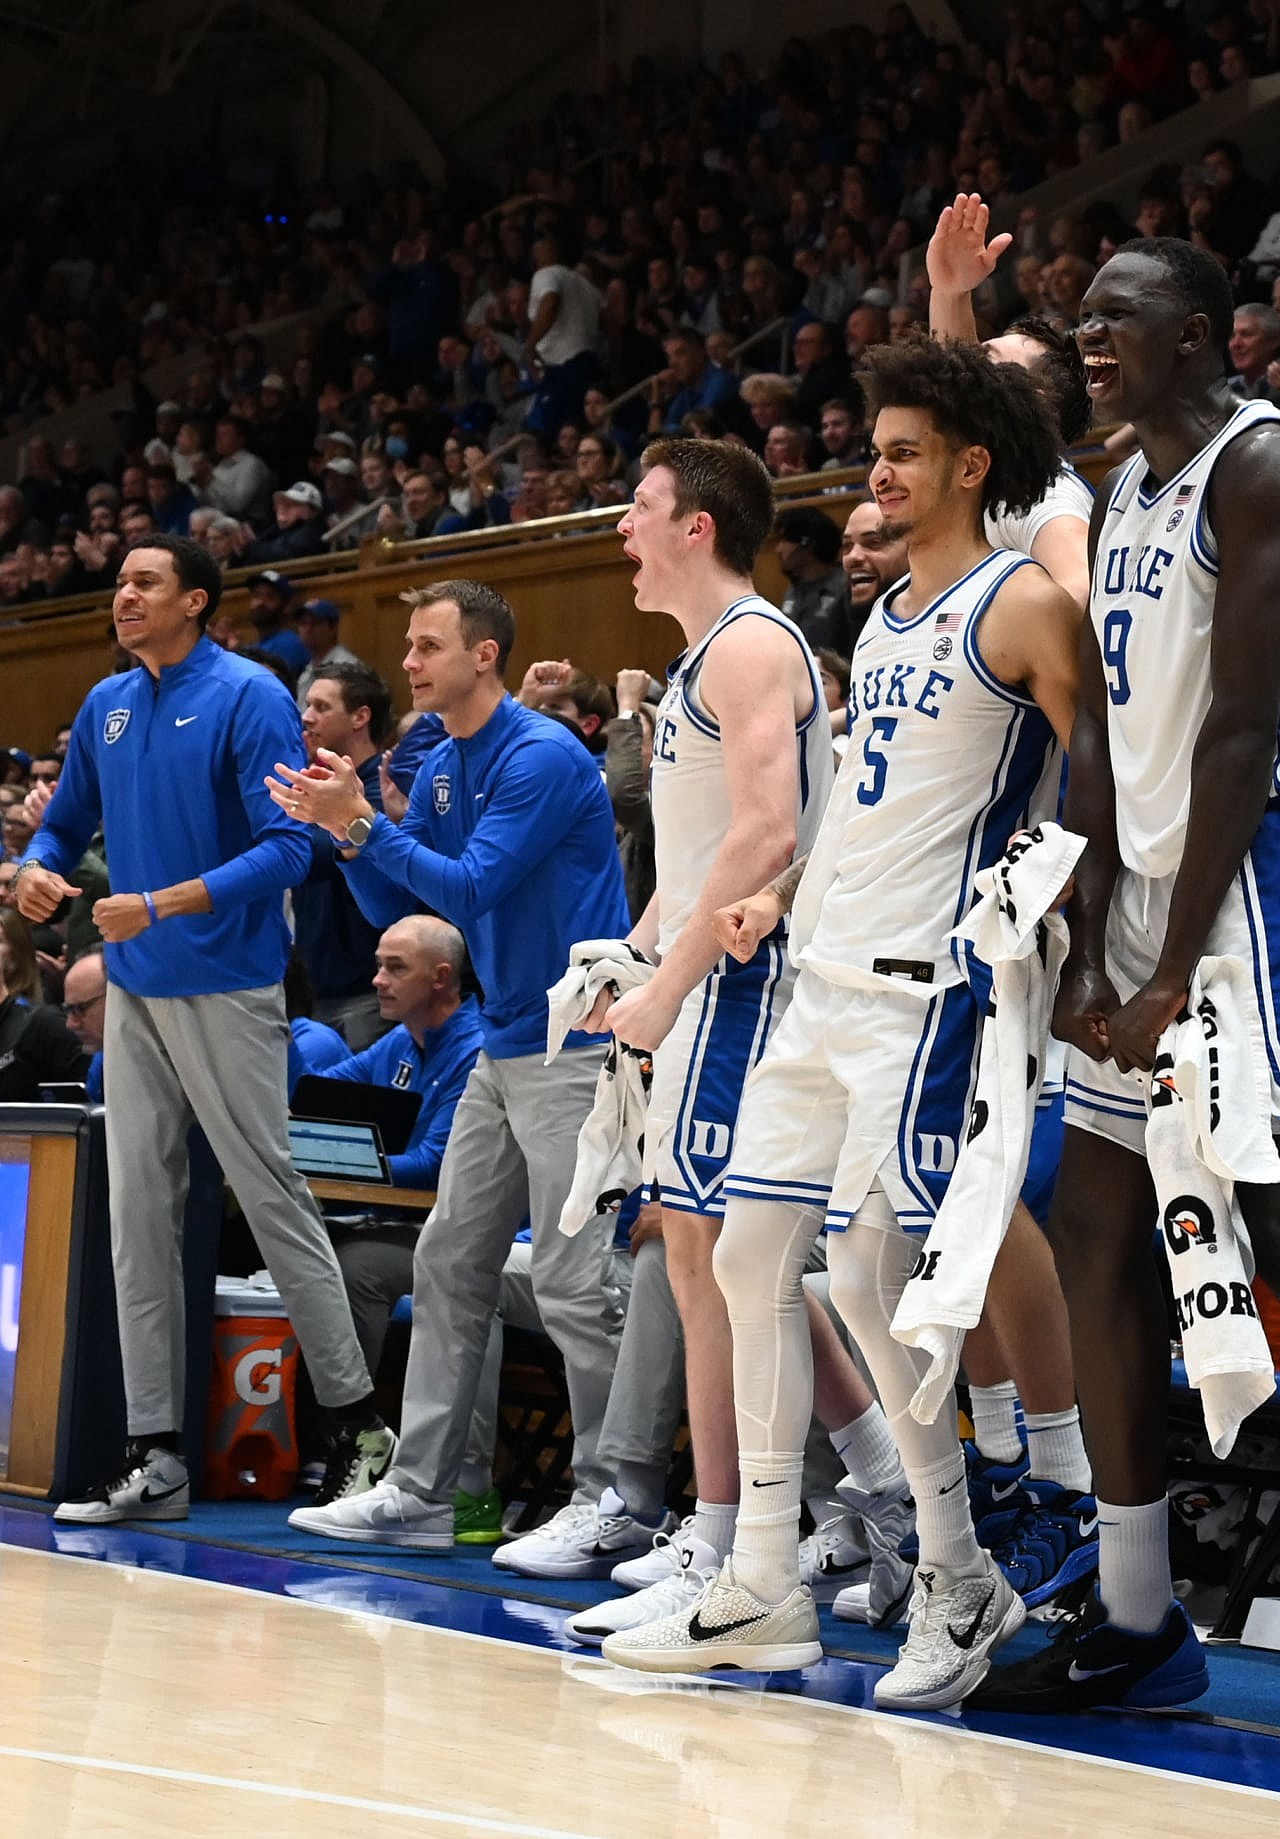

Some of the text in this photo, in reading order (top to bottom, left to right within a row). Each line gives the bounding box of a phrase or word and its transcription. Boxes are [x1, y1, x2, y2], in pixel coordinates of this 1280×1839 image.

[1103, 609, 1133, 705] 9
[857, 716, 898, 806] 5
[688, 1119, 730, 1159] D
[917, 1132, 956, 1173] D
[233, 1348, 282, 1406] G
